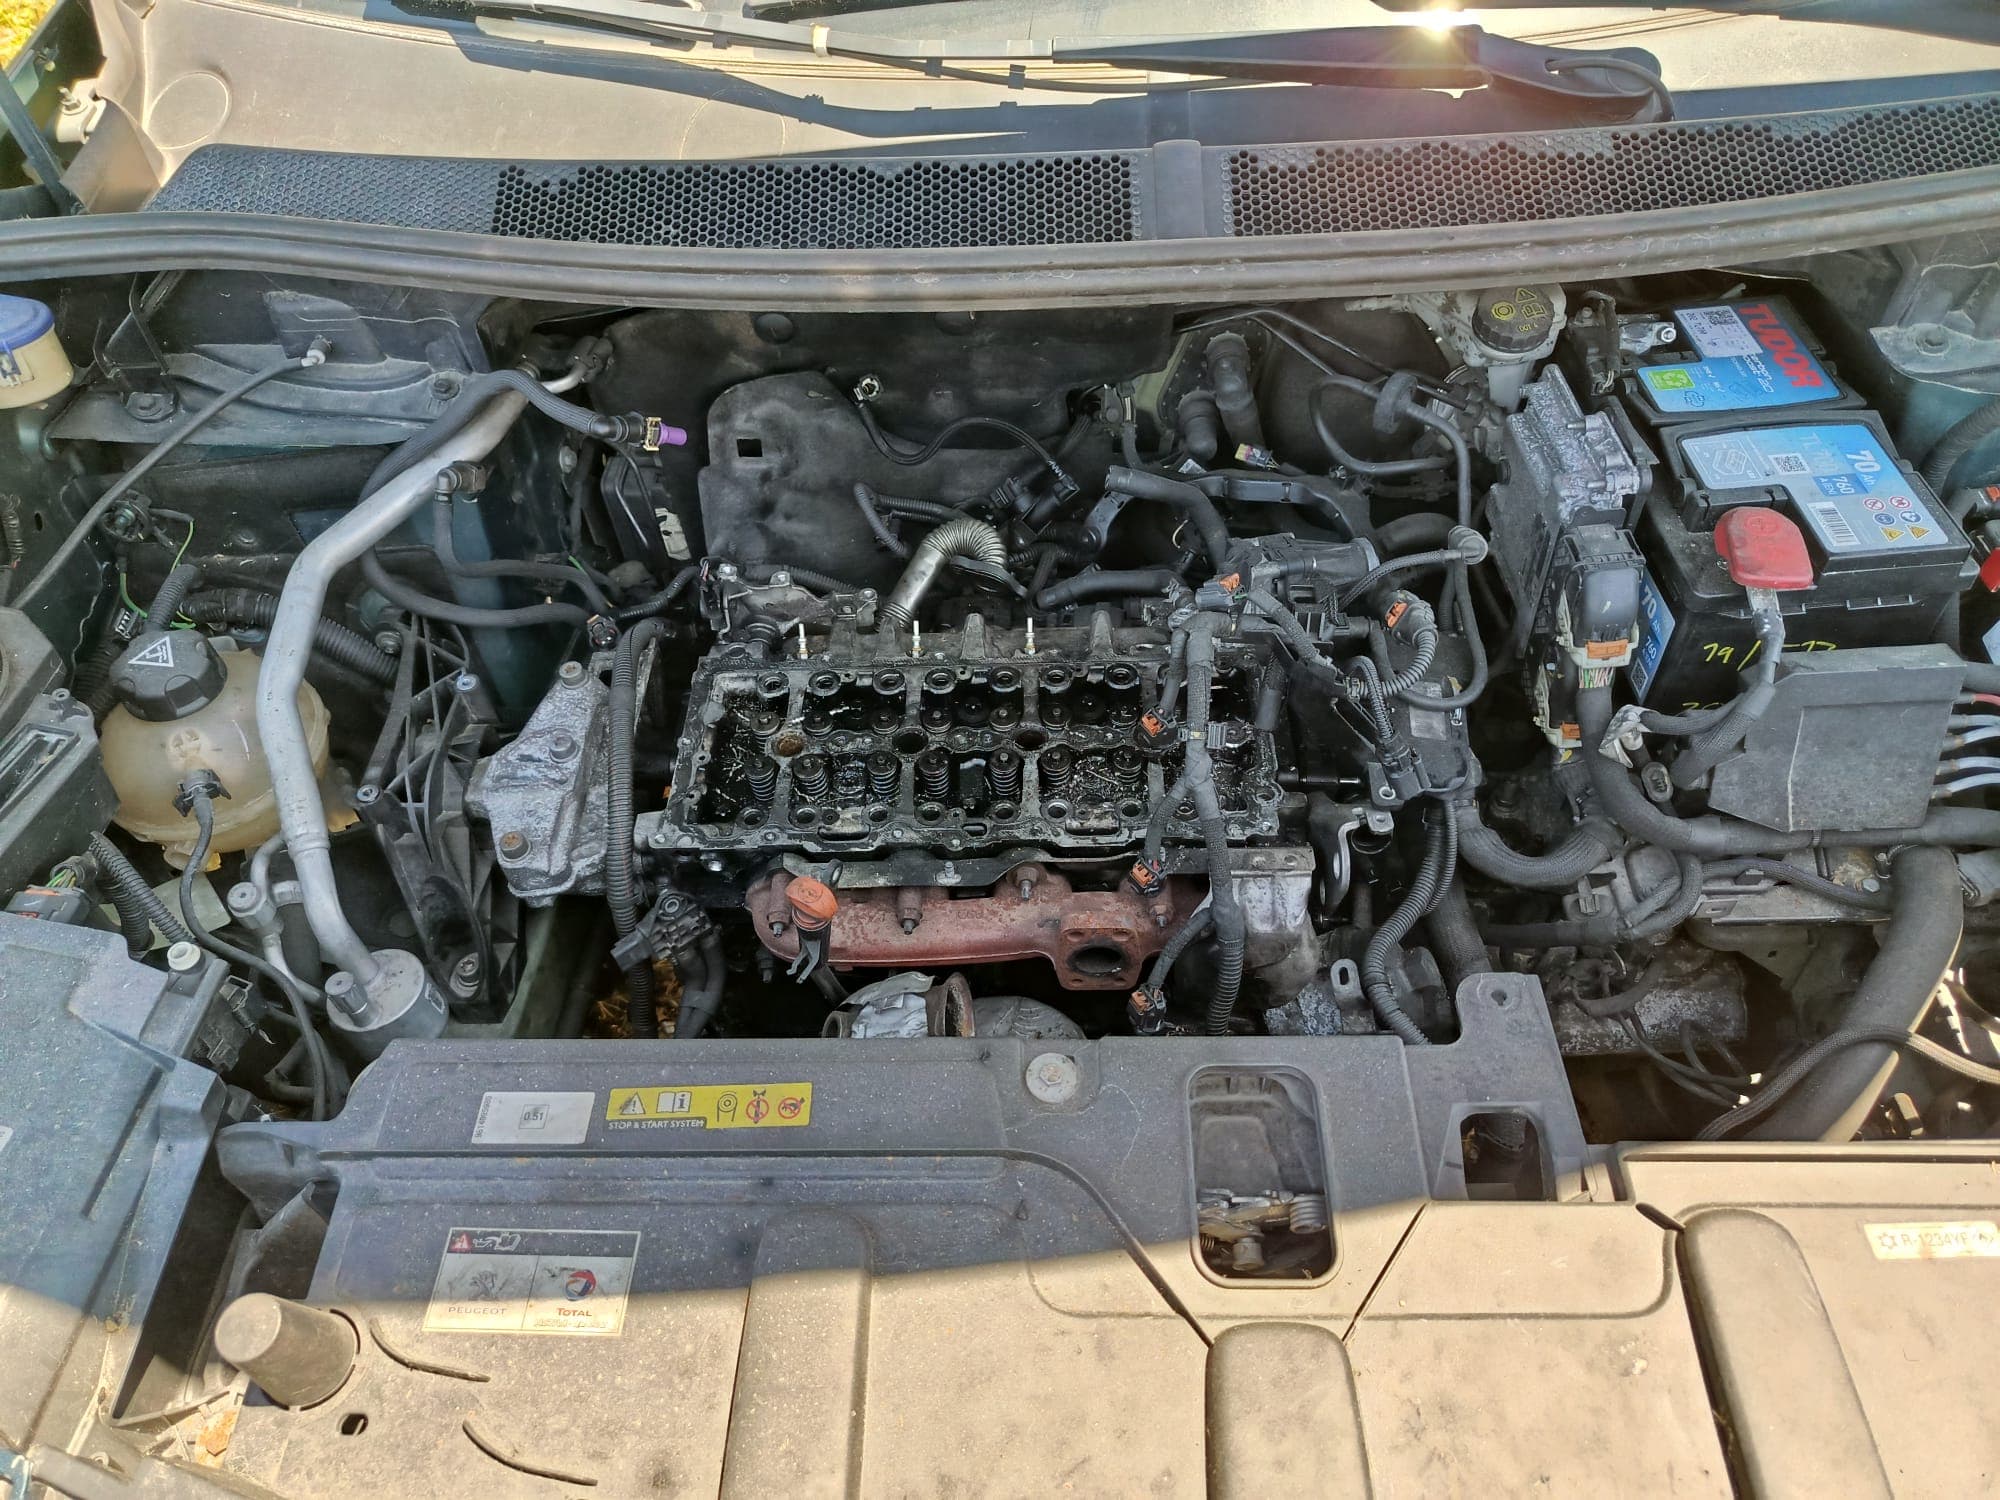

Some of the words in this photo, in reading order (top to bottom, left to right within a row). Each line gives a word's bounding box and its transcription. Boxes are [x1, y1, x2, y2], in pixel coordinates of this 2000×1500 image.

[1739, 304, 1824, 387] TUDOR
[1846, 450, 1880, 473] 70
[1833, 476, 1855, 494] 760
[1862, 474, 1877, 486] Ah
[1641, 584, 1657, 619] 70
[608, 1121, 632, 1130] STOP
[641, 1120, 669, 1129] START
[670, 1119, 704, 1128] SYSTEM
[448, 1306, 507, 1316] PEUGEOT
[556, 1307, 593, 1317] TOTAL
